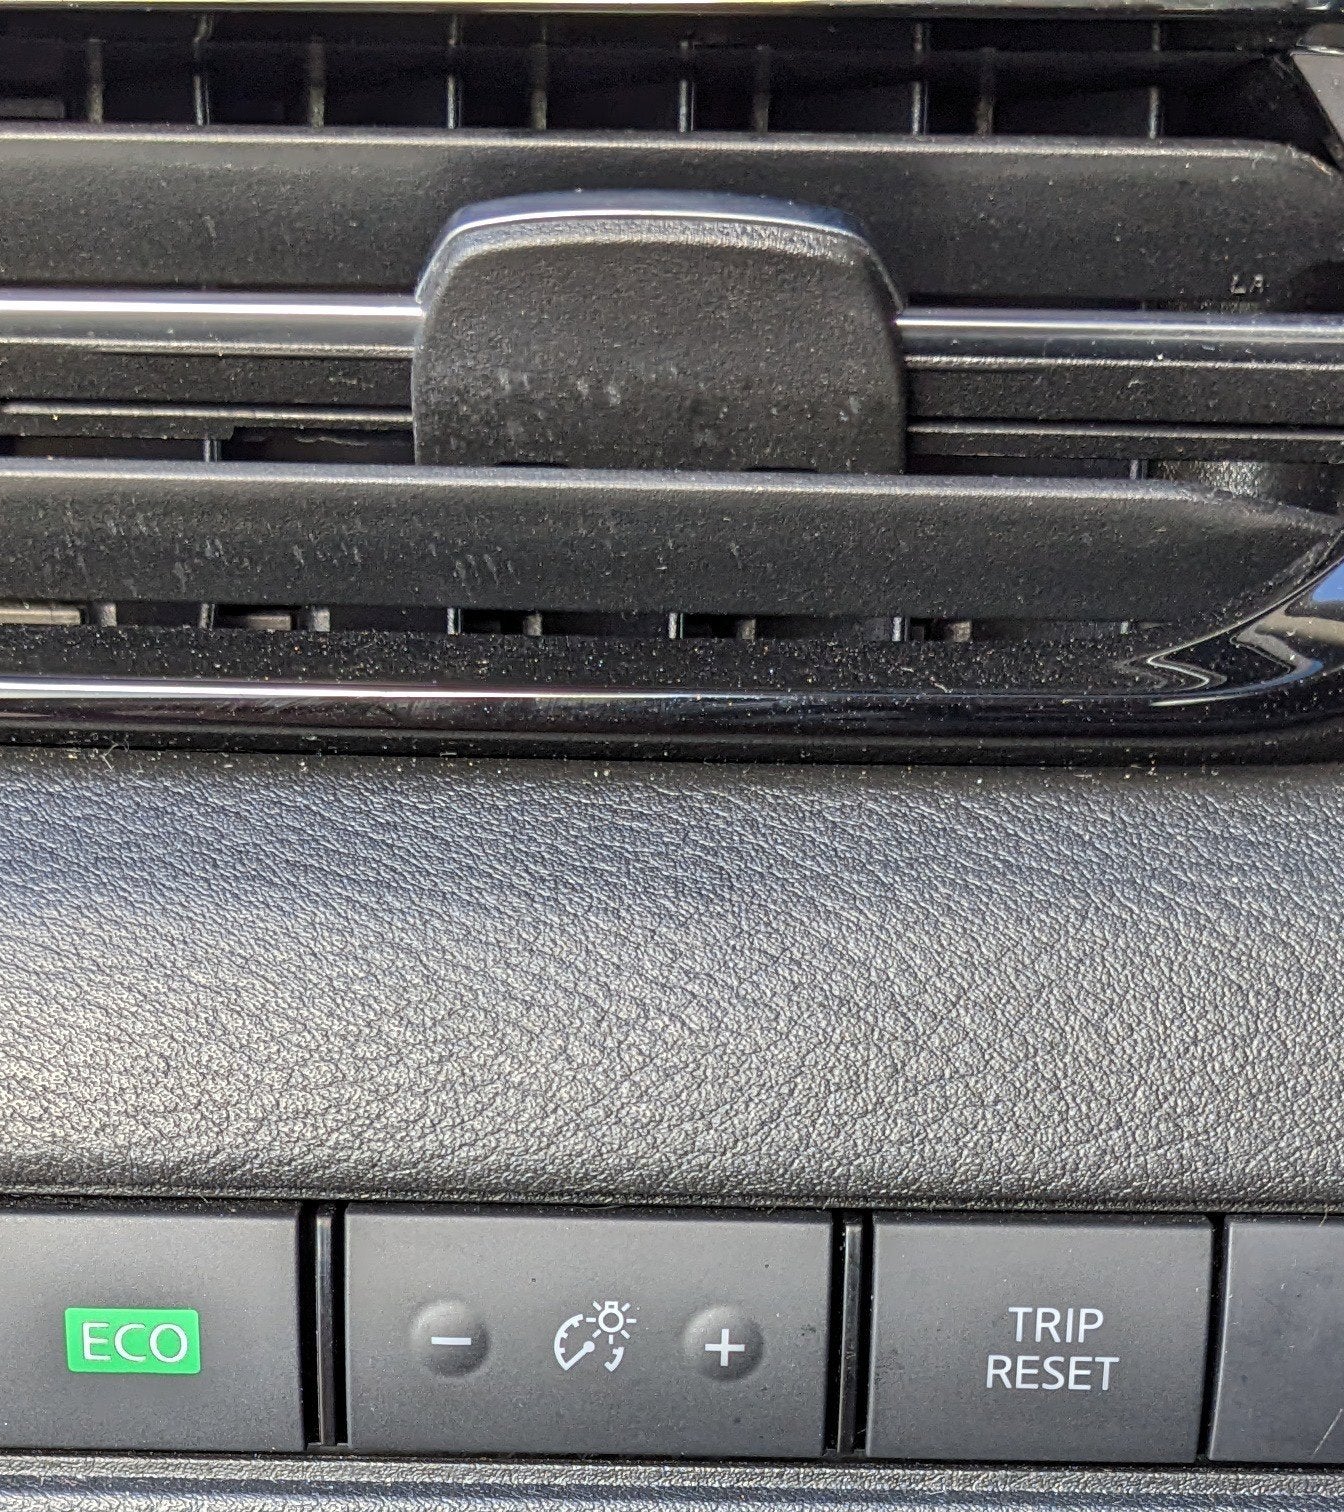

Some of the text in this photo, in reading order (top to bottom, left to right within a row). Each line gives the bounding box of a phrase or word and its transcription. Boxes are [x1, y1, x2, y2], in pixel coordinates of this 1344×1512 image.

[81, 1321, 188, 1364] ECO
[1008, 1306, 1104, 1343] TRIP
[986, 1354, 1120, 1391] RESET
